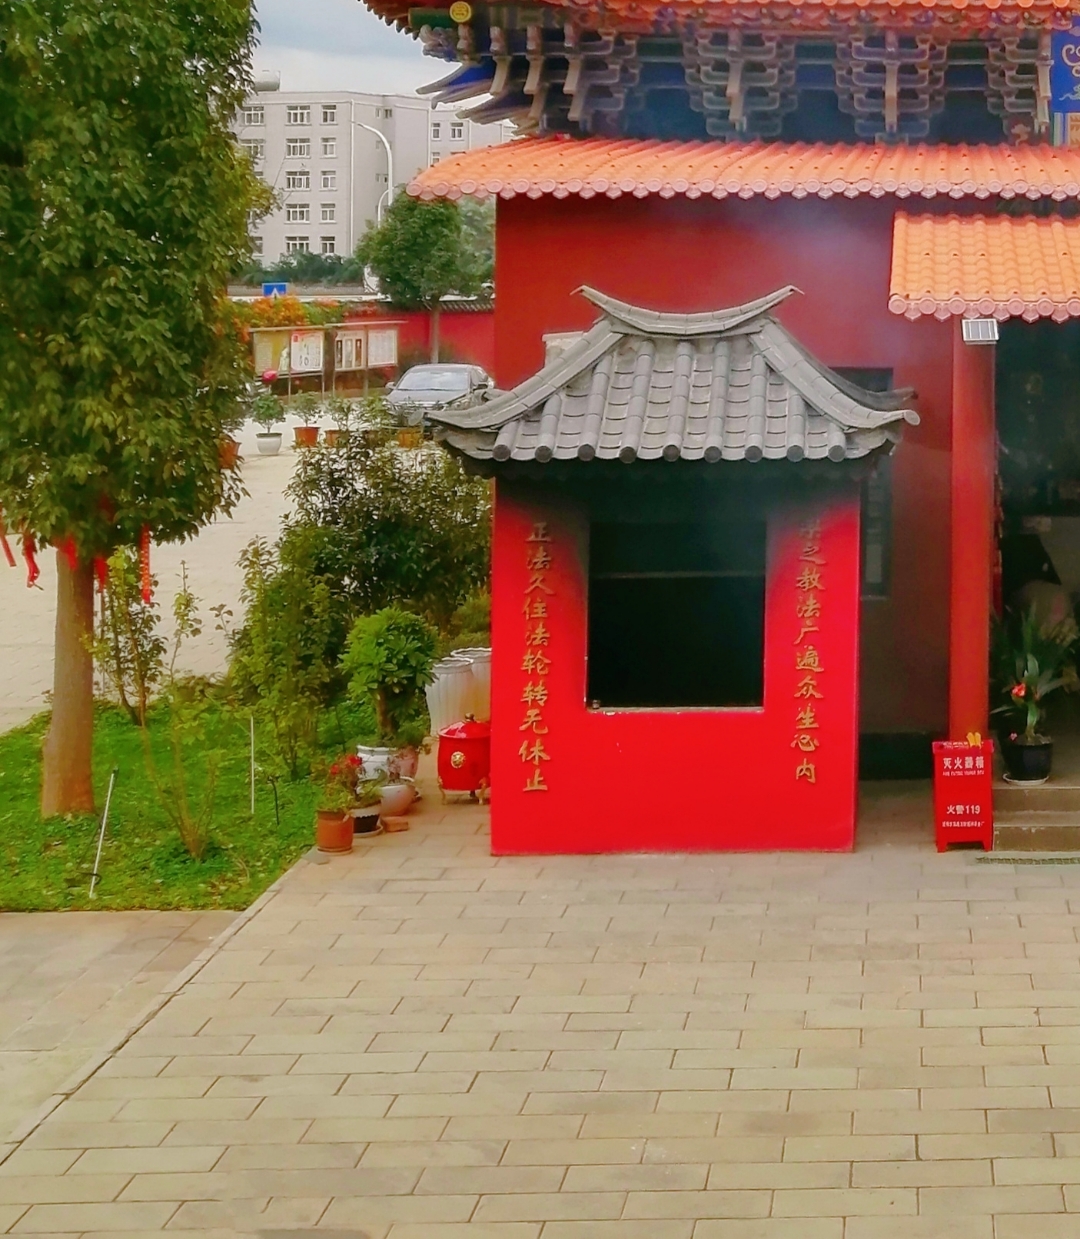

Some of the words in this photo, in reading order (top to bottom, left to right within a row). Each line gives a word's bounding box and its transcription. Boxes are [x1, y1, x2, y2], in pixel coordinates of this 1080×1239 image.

[518, 521, 554, 792] 正法久住法轮转无休止
